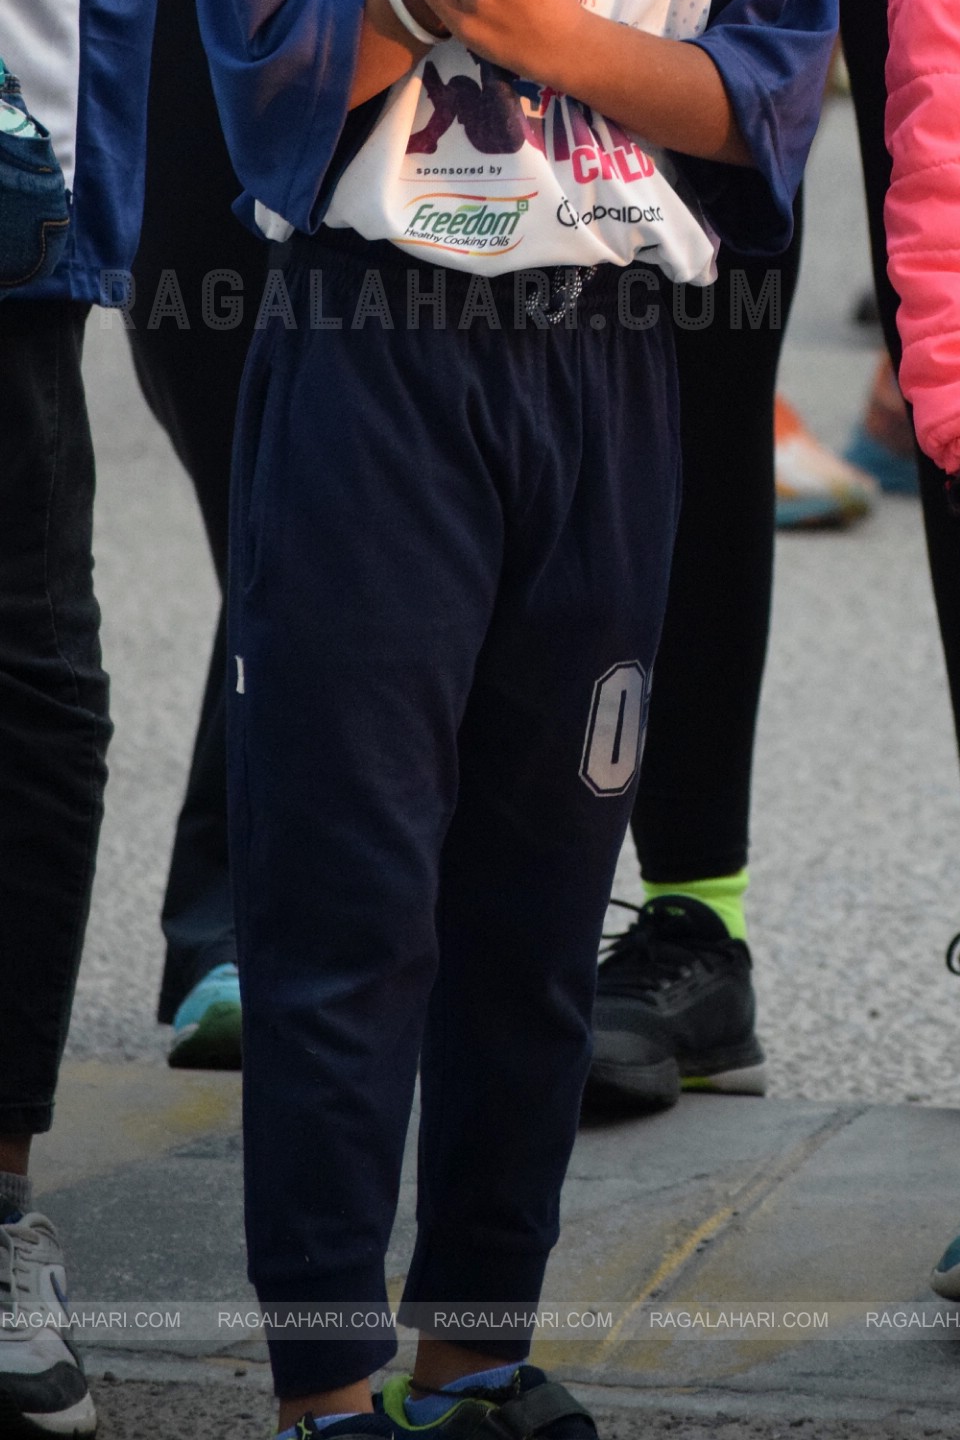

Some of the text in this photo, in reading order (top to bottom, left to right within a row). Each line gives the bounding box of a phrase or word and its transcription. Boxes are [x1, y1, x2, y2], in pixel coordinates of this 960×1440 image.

[416, 164, 503, 176] sponsored by
[408, 203, 520, 237] Freedom
[404, 228, 511, 248] Healthy Cooking Oils
